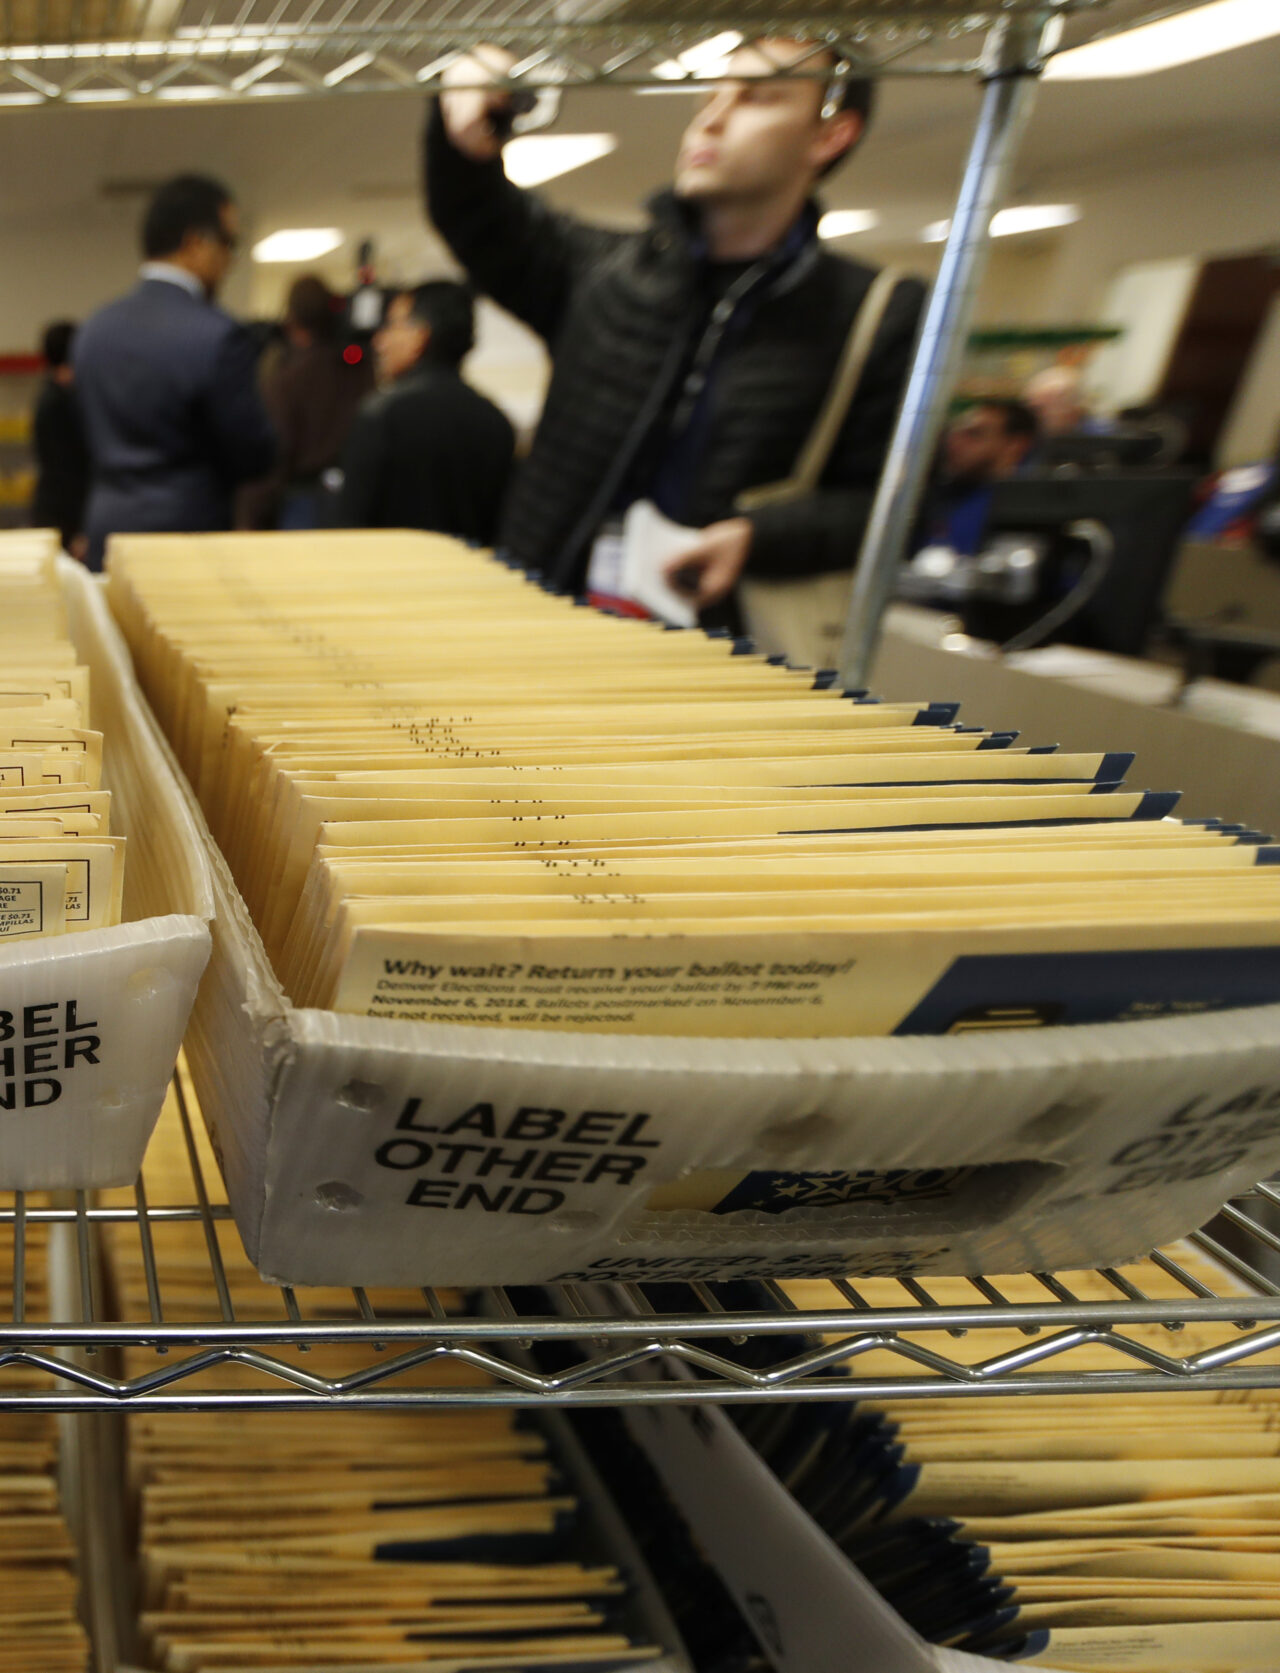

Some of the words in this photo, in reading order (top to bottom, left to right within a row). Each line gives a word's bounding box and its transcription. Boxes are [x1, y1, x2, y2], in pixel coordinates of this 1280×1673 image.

[8, 912, 31, 921] $0.71
[384, 959, 442, 979] Why
[449, 963, 523, 979] wait?
[527, 964, 616, 980] Return
[622, 965, 684, 980] your
[686, 960, 765, 977] ballot
[376, 979, 437, 992] Denver
[440, 981, 517, 993] Elections
[372, 994, 461, 1008] November
[366, 1008, 396, 1018] but
[398, 1010, 429, 1020] not
[395, 1097, 661, 1148] LABEL
[374, 1137, 646, 1185] OTHER
[405, 1178, 566, 1215] END
[588, 1254, 768, 1270] UNITED
